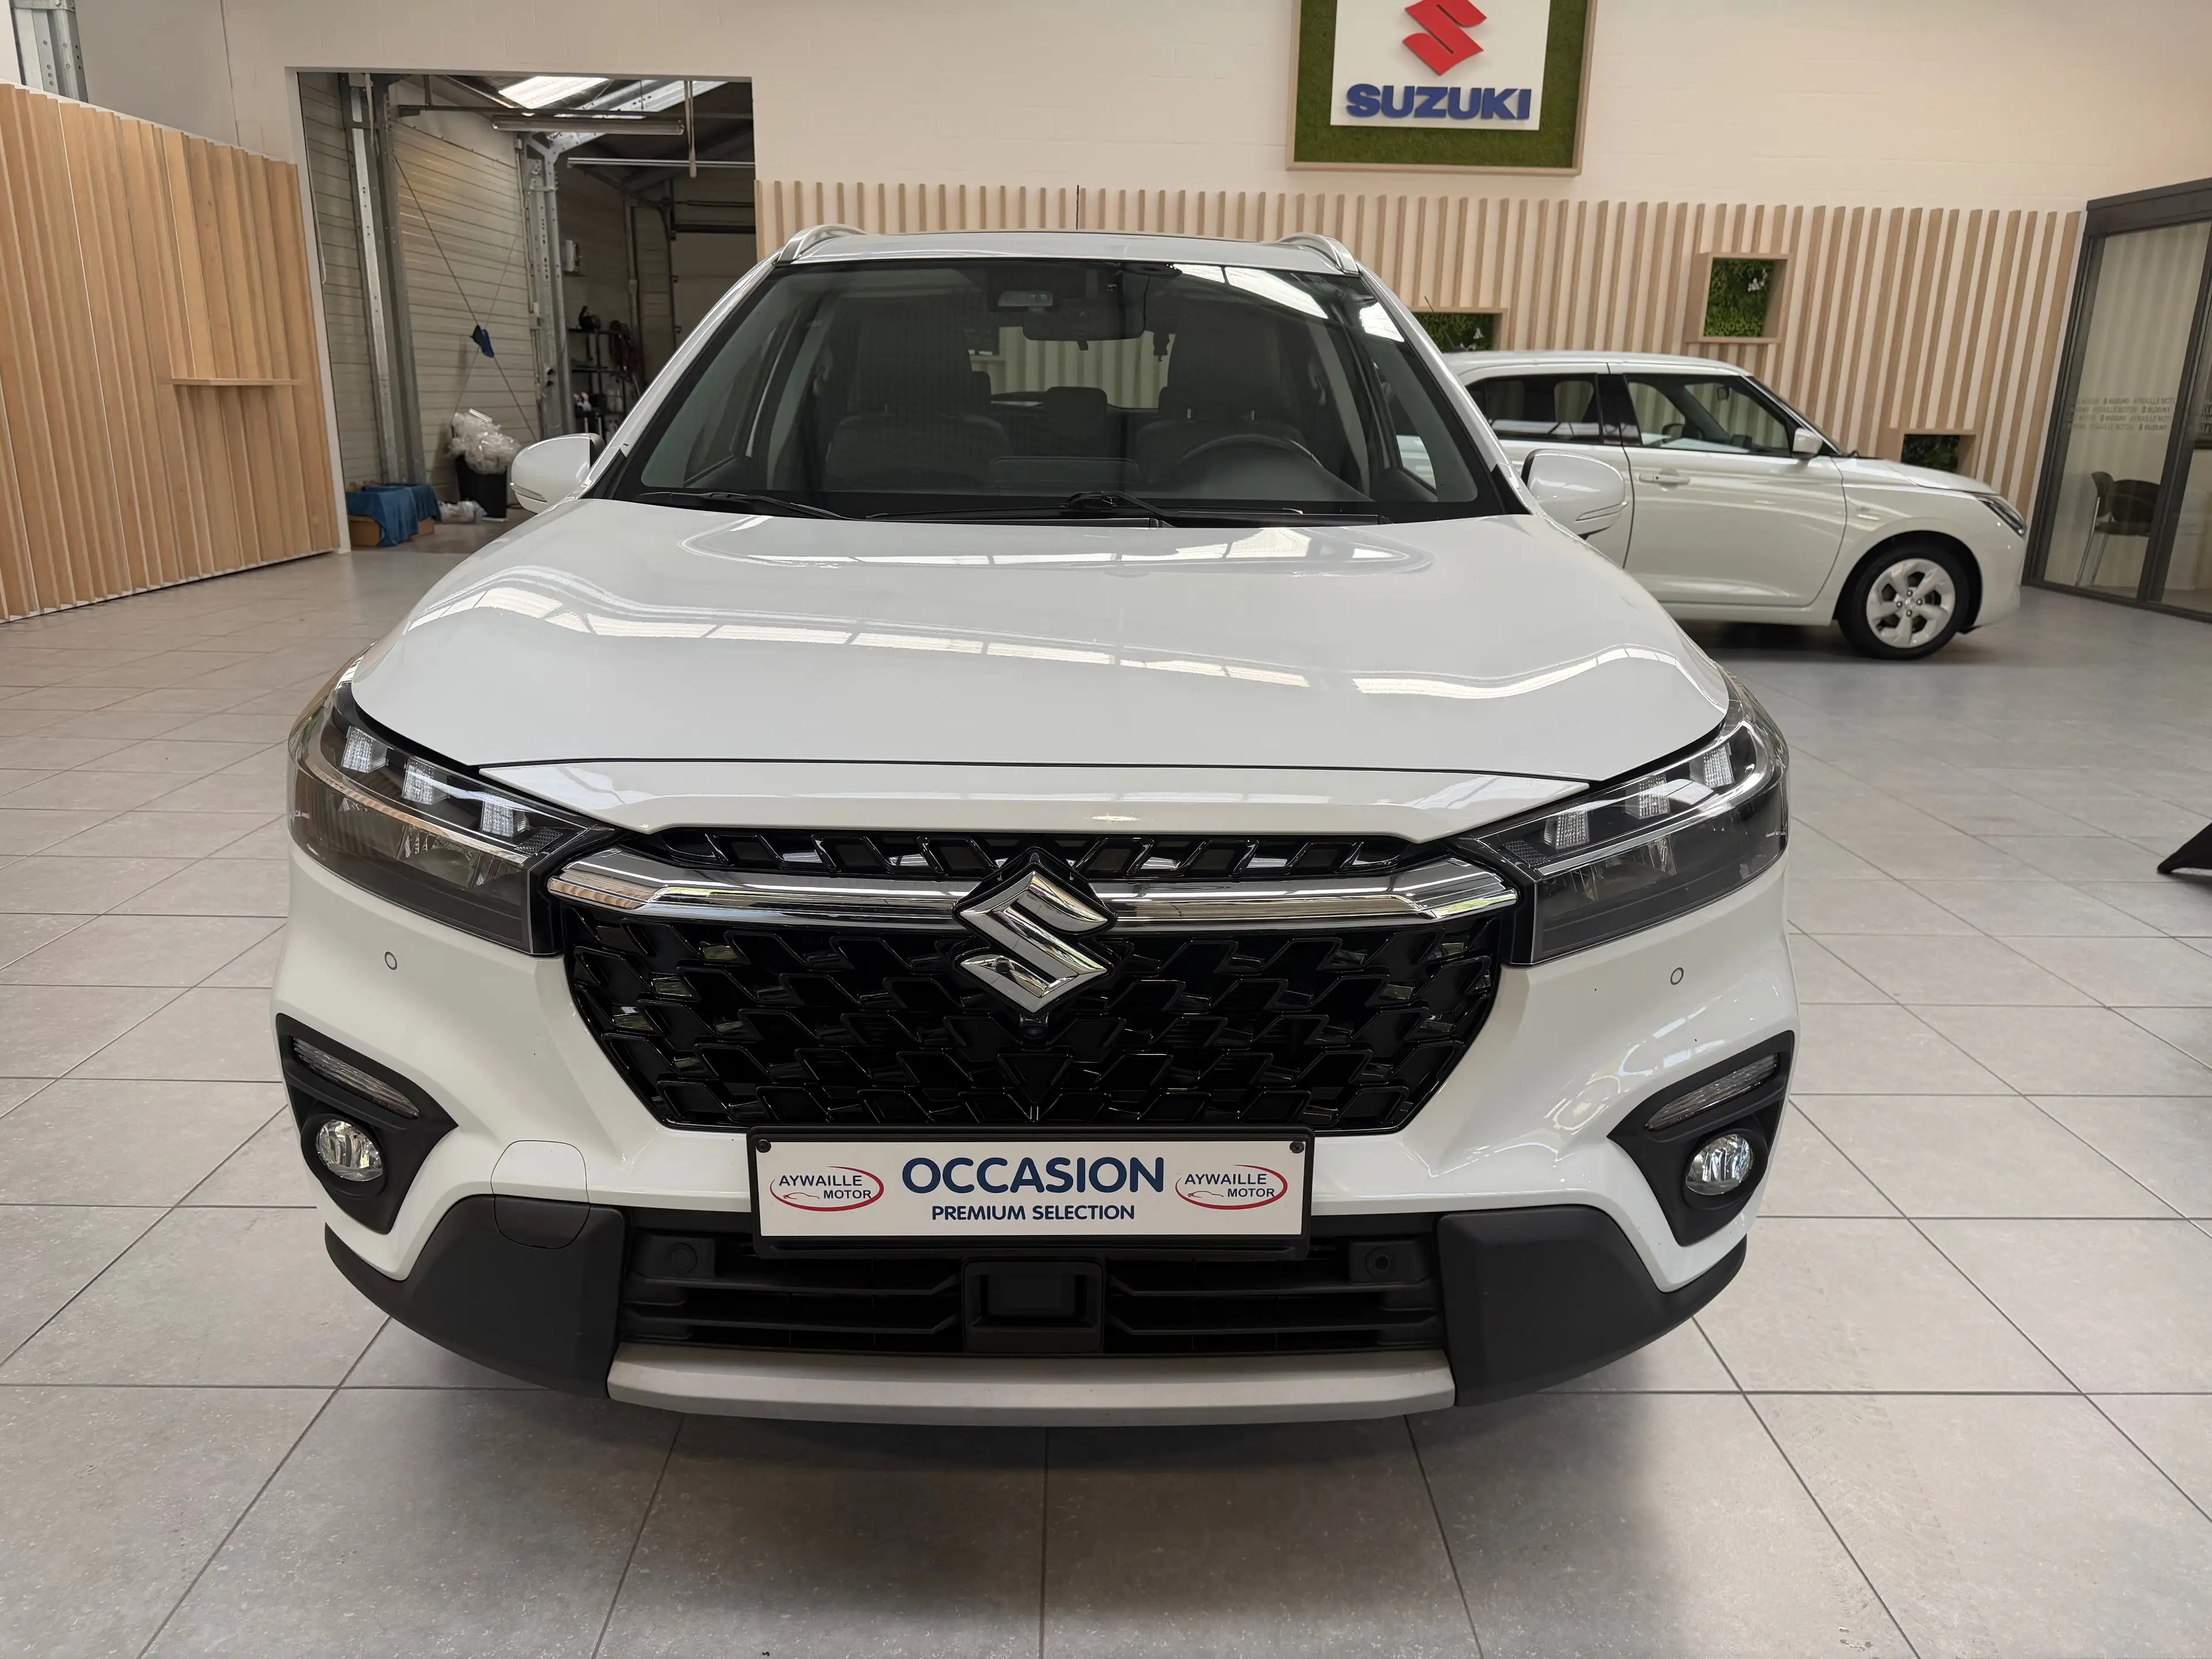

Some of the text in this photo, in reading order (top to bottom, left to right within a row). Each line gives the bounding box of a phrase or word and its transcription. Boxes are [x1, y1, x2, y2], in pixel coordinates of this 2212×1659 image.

[1346, 84, 1532, 120] SUZUKI
[779, 1175, 862, 1186] AYWAILLE
[902, 1157, 1165, 1194] OCCASION
[1184, 1173, 1267, 1185] AYWAILLE
[823, 1190, 872, 1199] MOTOR
[1228, 1188, 1275, 1198] MOTOR
[932, 1206, 1135, 1221] PREMIUM SELECTION
